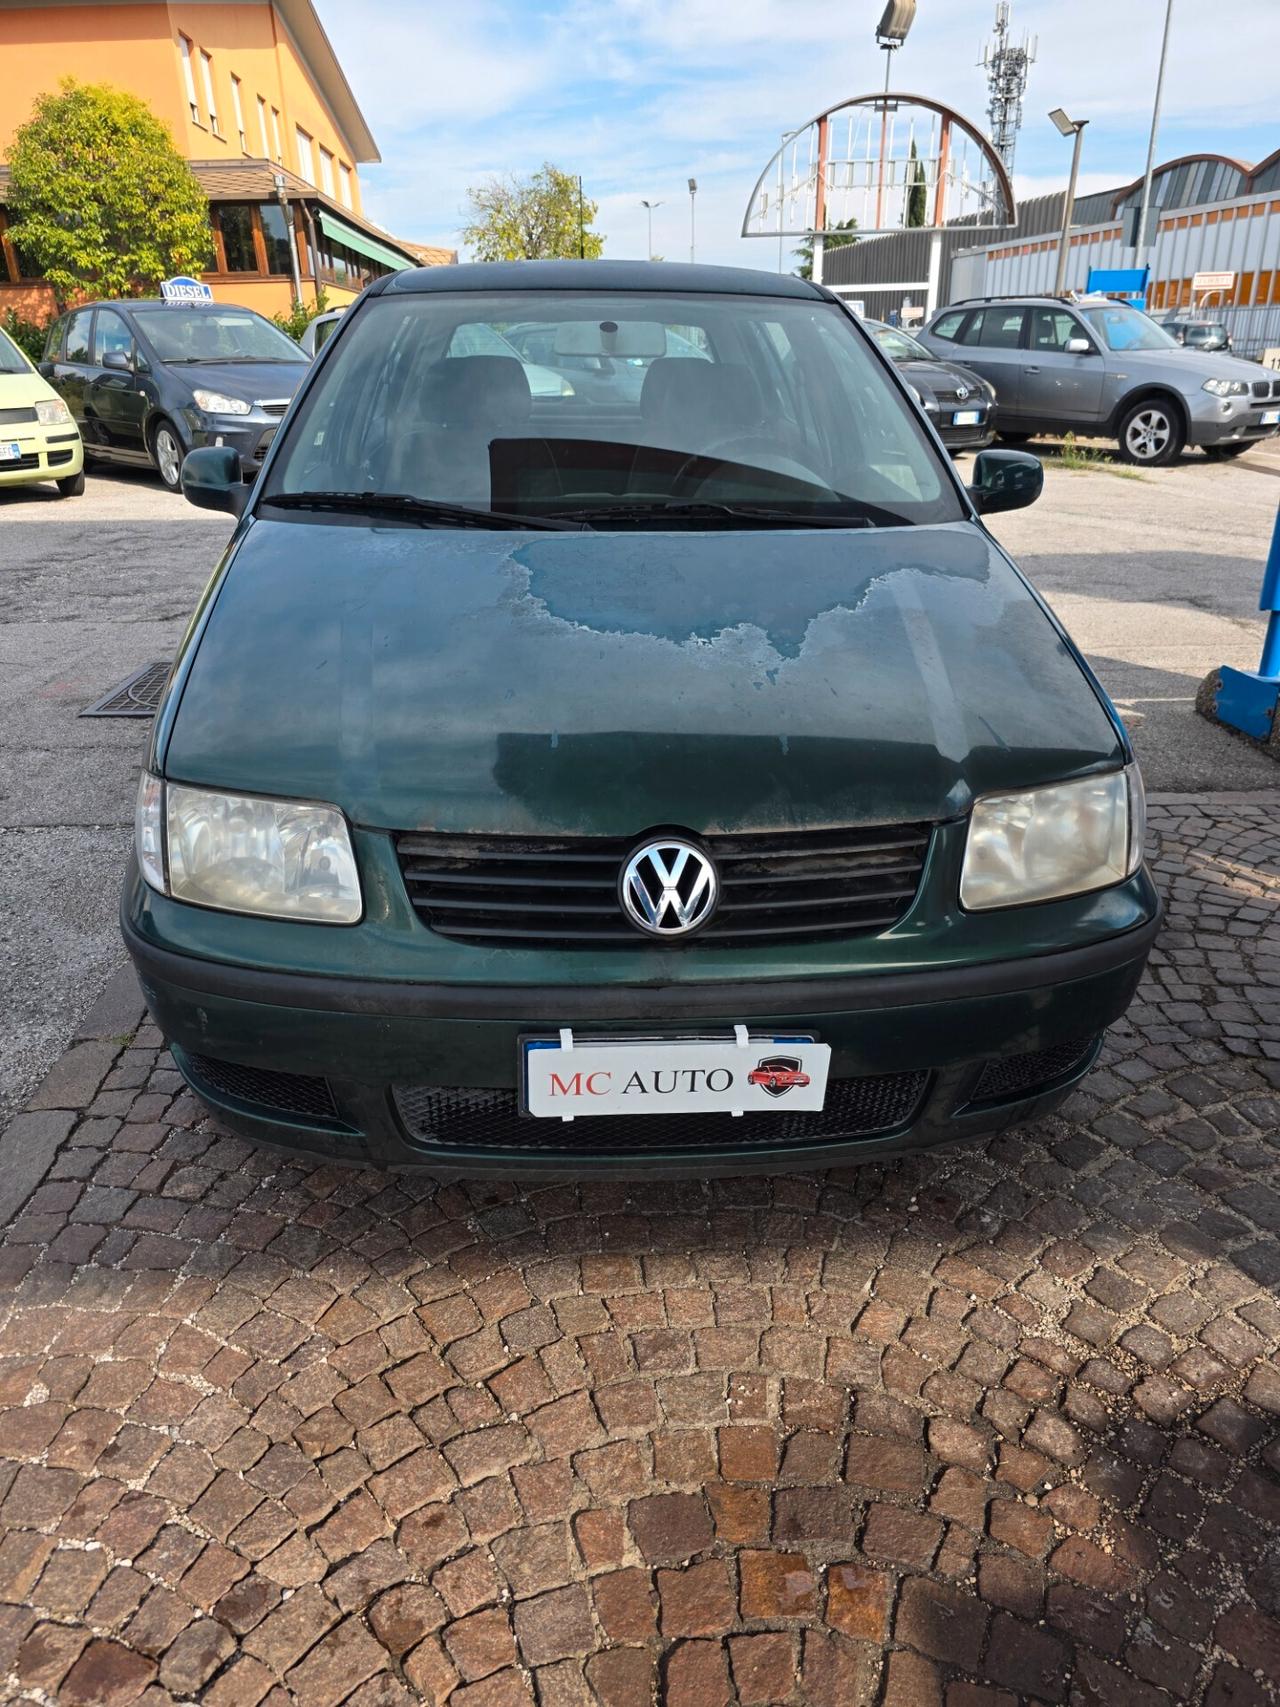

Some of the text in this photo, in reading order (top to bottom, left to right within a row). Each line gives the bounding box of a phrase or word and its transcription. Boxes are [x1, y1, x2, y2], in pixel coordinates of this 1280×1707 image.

[165, 284, 210, 299] DIESEL
[548, 1068, 734, 1097] MC AUTO
